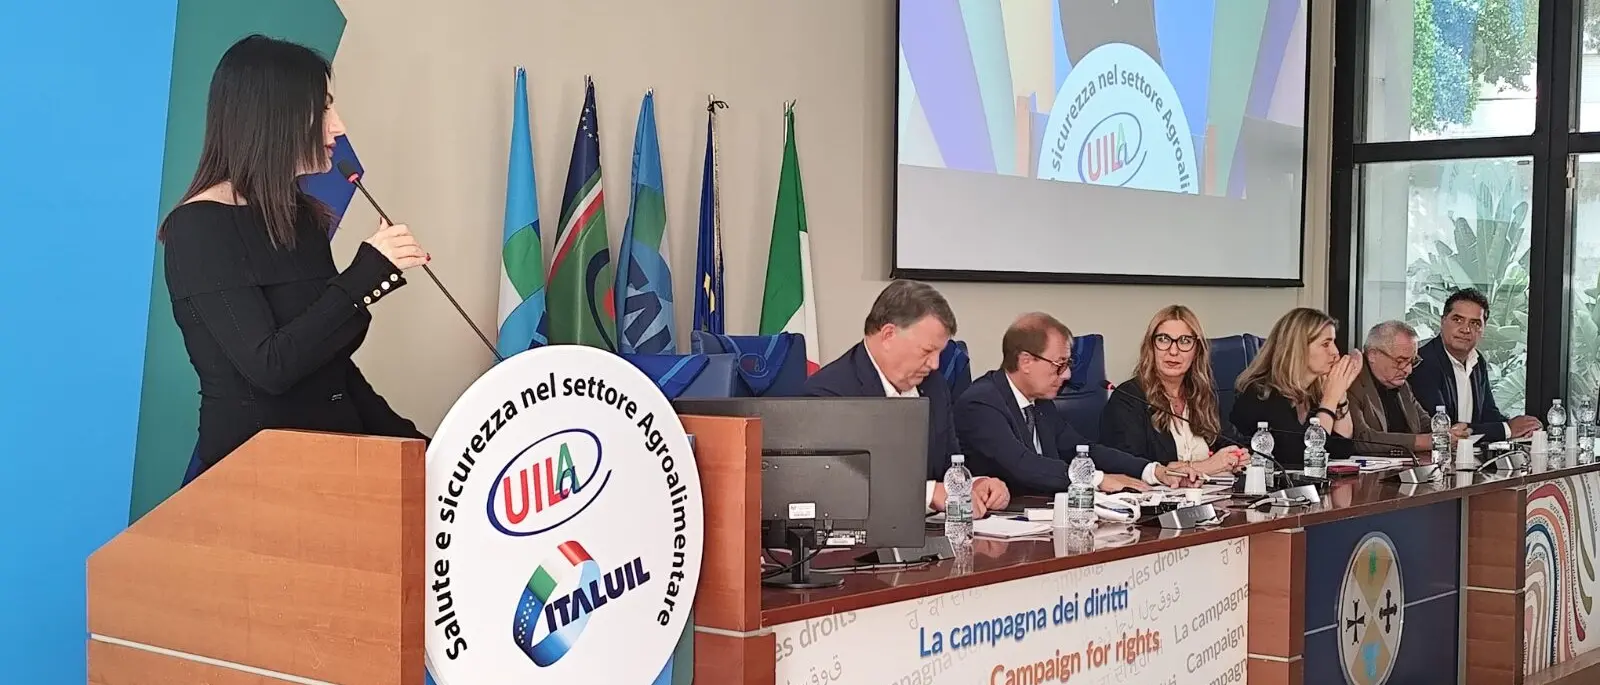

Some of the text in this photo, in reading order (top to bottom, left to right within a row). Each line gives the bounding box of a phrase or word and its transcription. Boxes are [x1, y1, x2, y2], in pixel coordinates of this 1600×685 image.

[1051, 64, 1190, 193] sicurezza nel settore Agroali
[431, 372, 687, 661] Salute e sicurezza nel settore Agroalimentare
[544, 556, 650, 634] ITALUIL
[1128, 567, 1150, 590] des
[920, 627, 943, 657] La
[949, 607, 1047, 649] campagna
[1052, 592, 1079, 626] dei
[1084, 581, 1129, 618] diritti
[1174, 583, 1249, 644] La campagna
[990, 649, 1081, 685] Campaign
[1086, 640, 1111, 671] for
[1116, 628, 1160, 664] rights
[1186, 624, 1245, 674] Campaign
